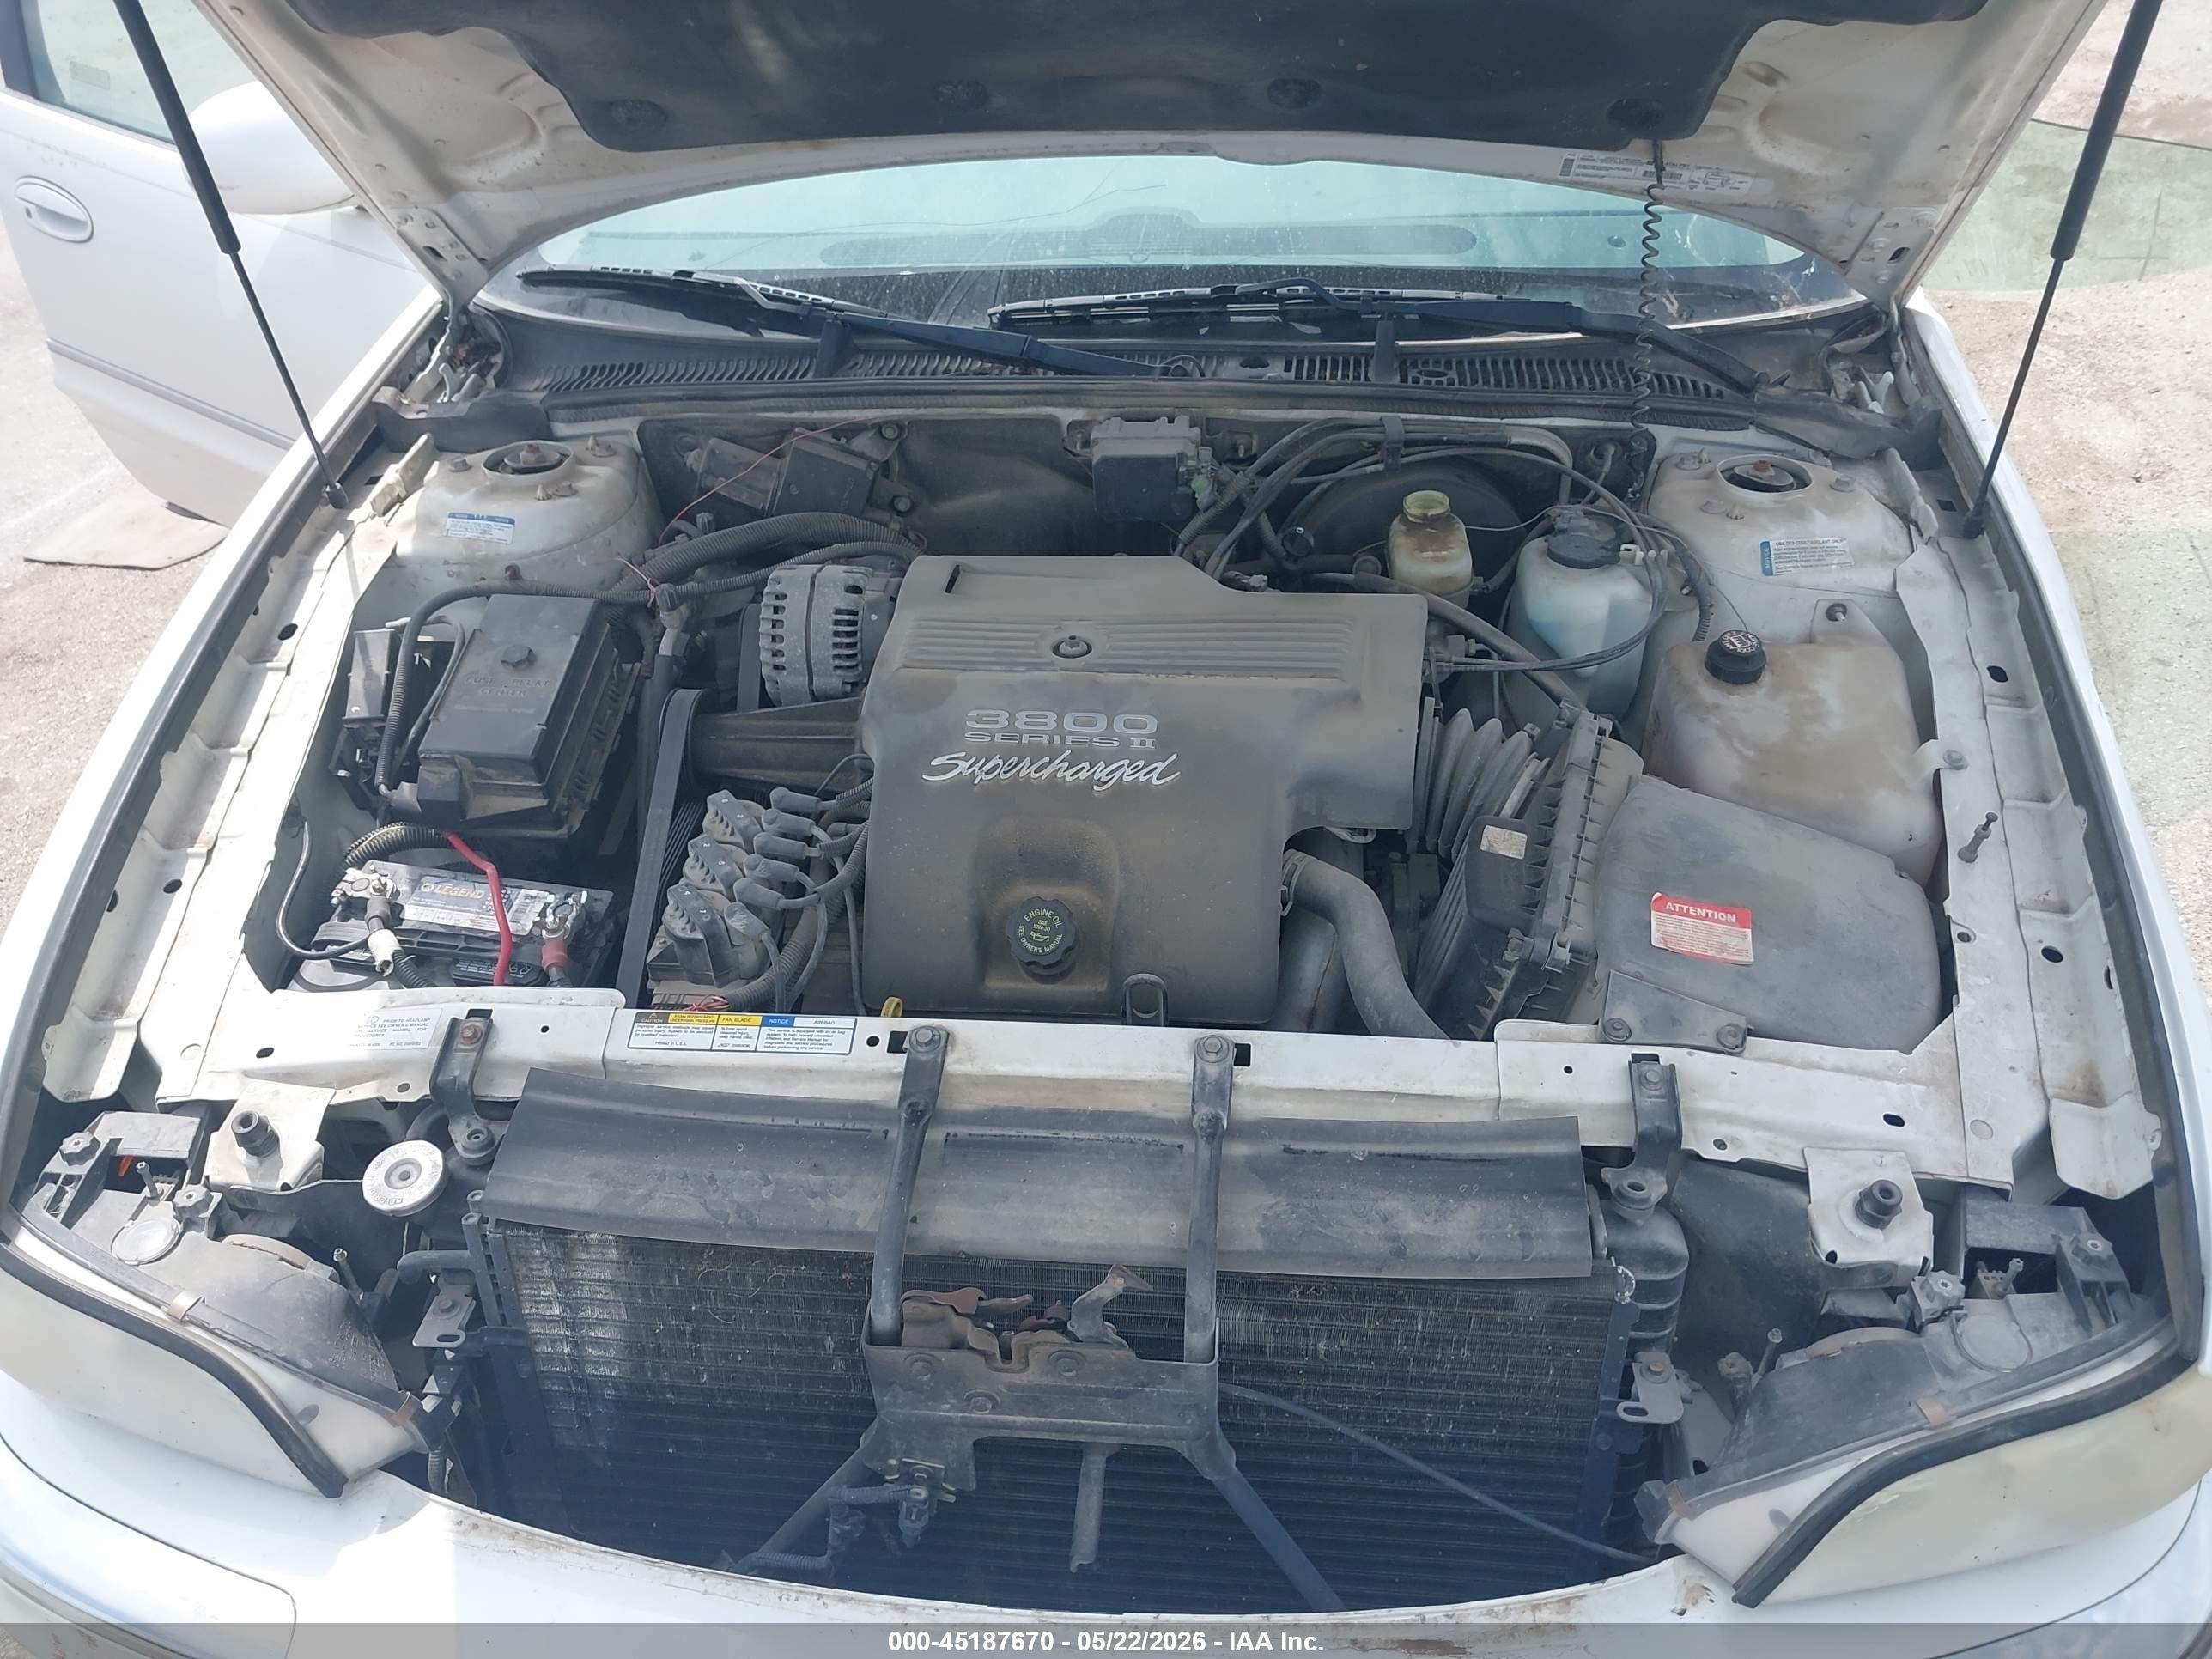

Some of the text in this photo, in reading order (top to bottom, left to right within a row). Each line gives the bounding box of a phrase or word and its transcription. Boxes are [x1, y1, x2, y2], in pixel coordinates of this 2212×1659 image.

[965, 709, 1158, 734] 3800
[963, 732, 1156, 749] SERIES II
[921, 750, 1181, 792] Supercharged
[434, 884, 485, 899] LEGEND
[1024, 908, 1063, 928] ENGINE OIL
[1665, 902, 1736, 923] ATTENTION
[1044, 933, 1063, 952] MANUAL
